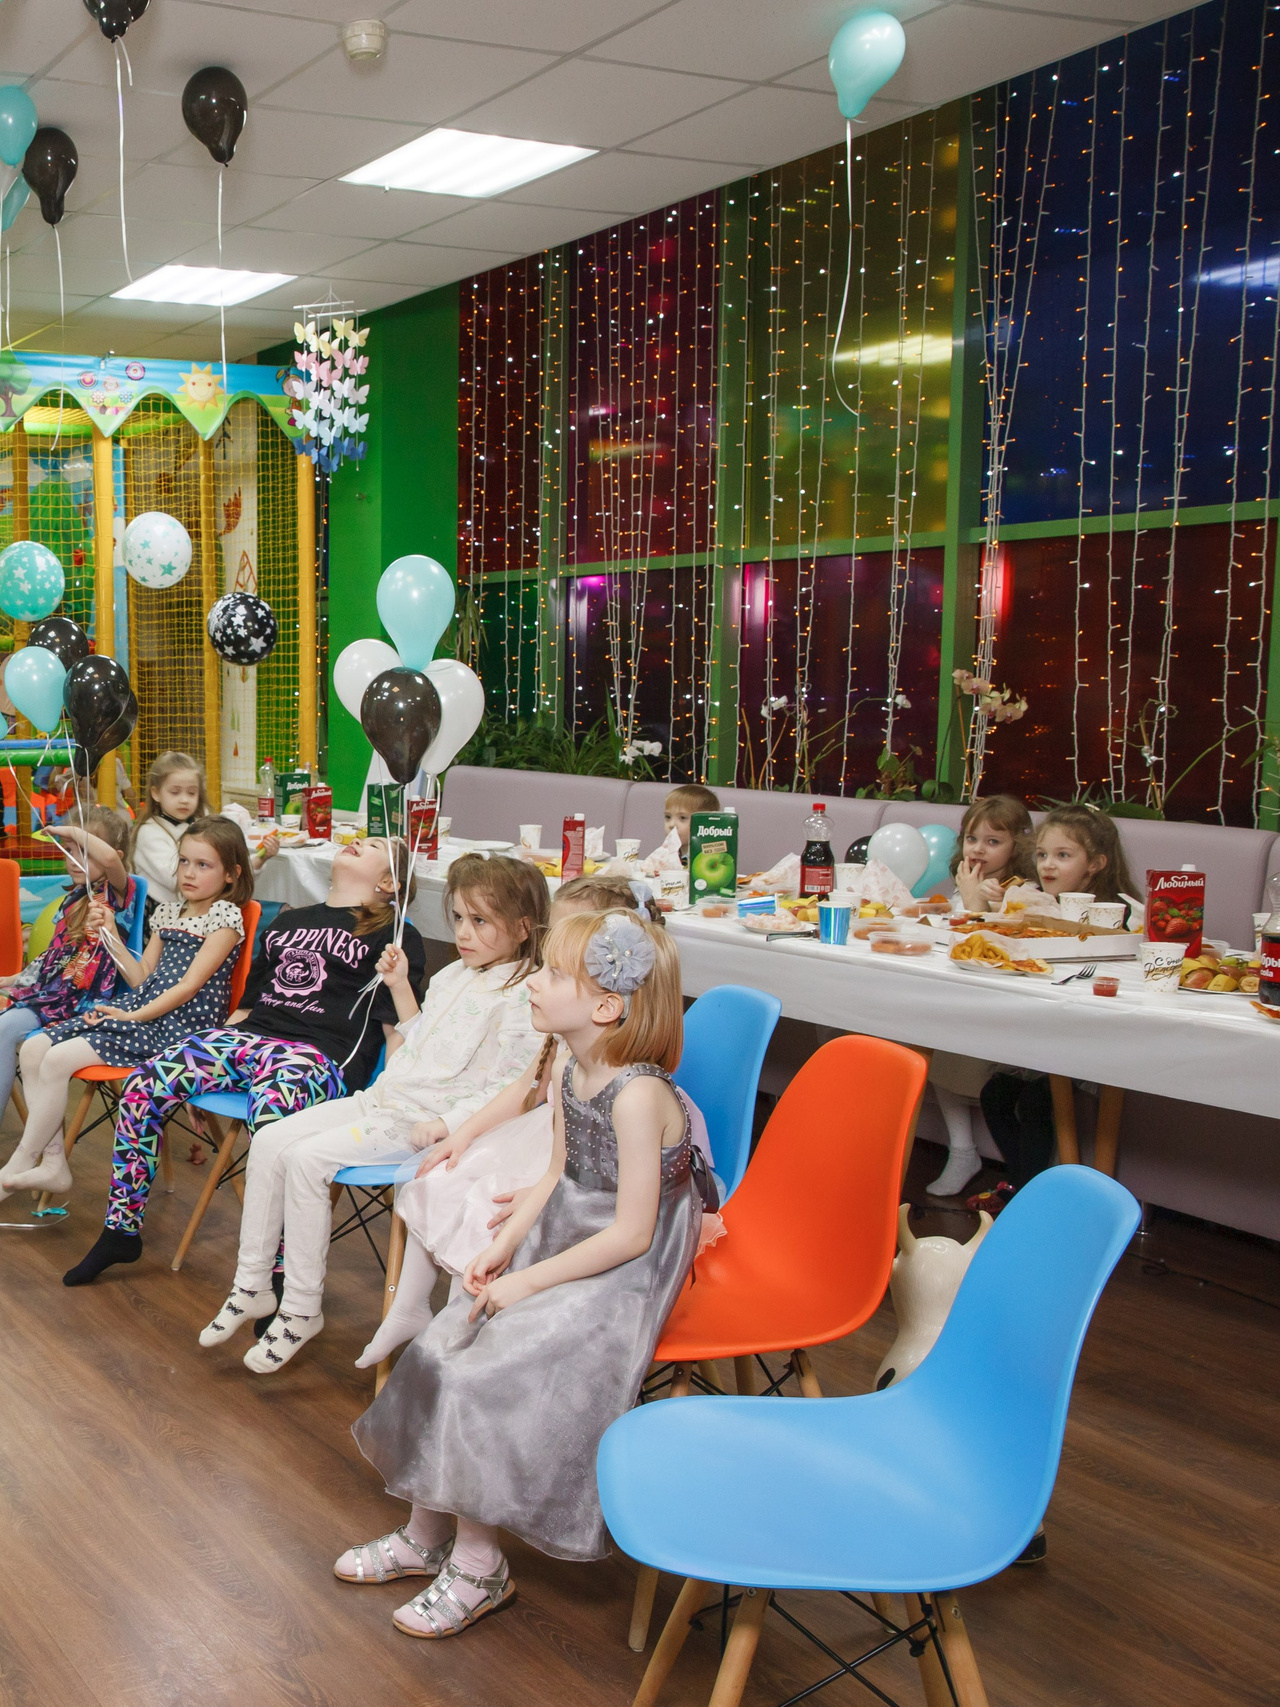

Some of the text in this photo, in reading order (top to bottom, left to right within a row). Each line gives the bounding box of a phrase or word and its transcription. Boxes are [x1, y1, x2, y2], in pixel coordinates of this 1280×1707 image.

[697, 826, 733, 837] Добрый
[1154, 875, 1204, 891] Любимый
[284, 999, 309, 1009] and
[300, 1000, 326, 1013] fun
